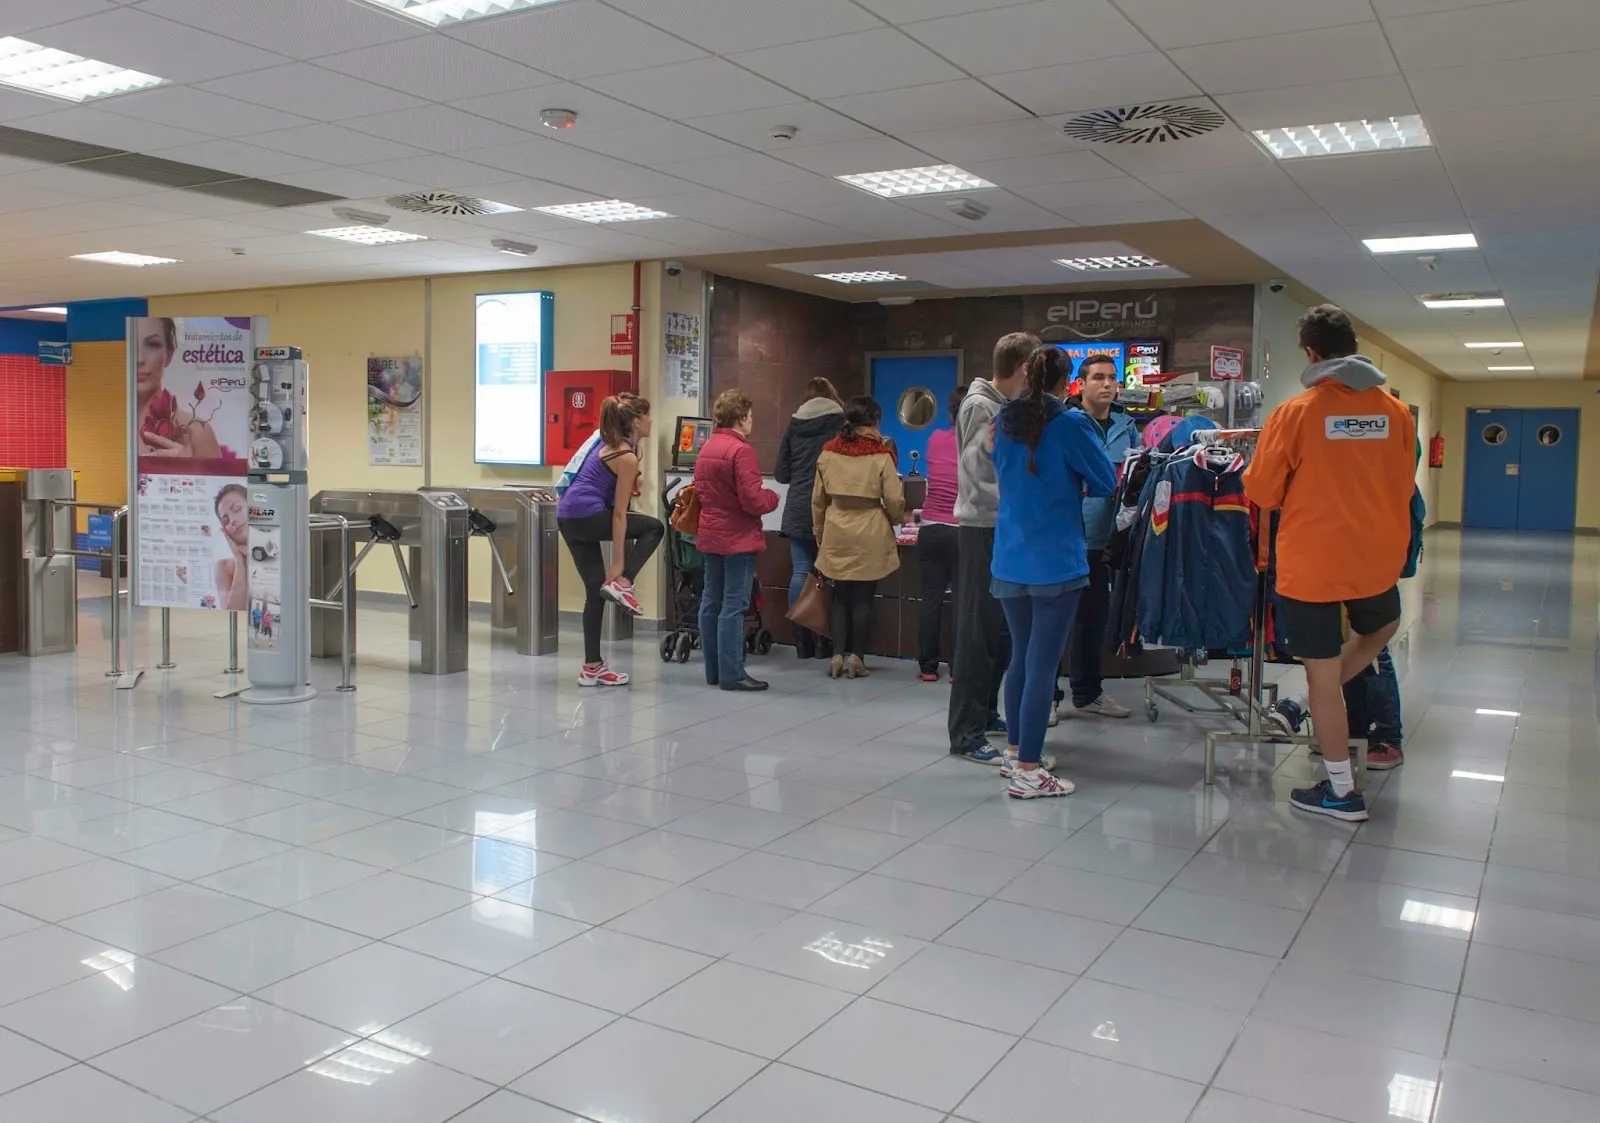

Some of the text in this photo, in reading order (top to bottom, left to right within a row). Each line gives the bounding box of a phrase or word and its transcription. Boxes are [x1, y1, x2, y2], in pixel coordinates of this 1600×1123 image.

[1047, 293, 1158, 321] elPerú
[184, 331, 243, 341] tratamientos de
[182, 343, 246, 363] estética
[259, 349, 285, 357] POLAR
[1087, 348, 1120, 357] DANCE
[1334, 417, 1386, 428] elPerú
